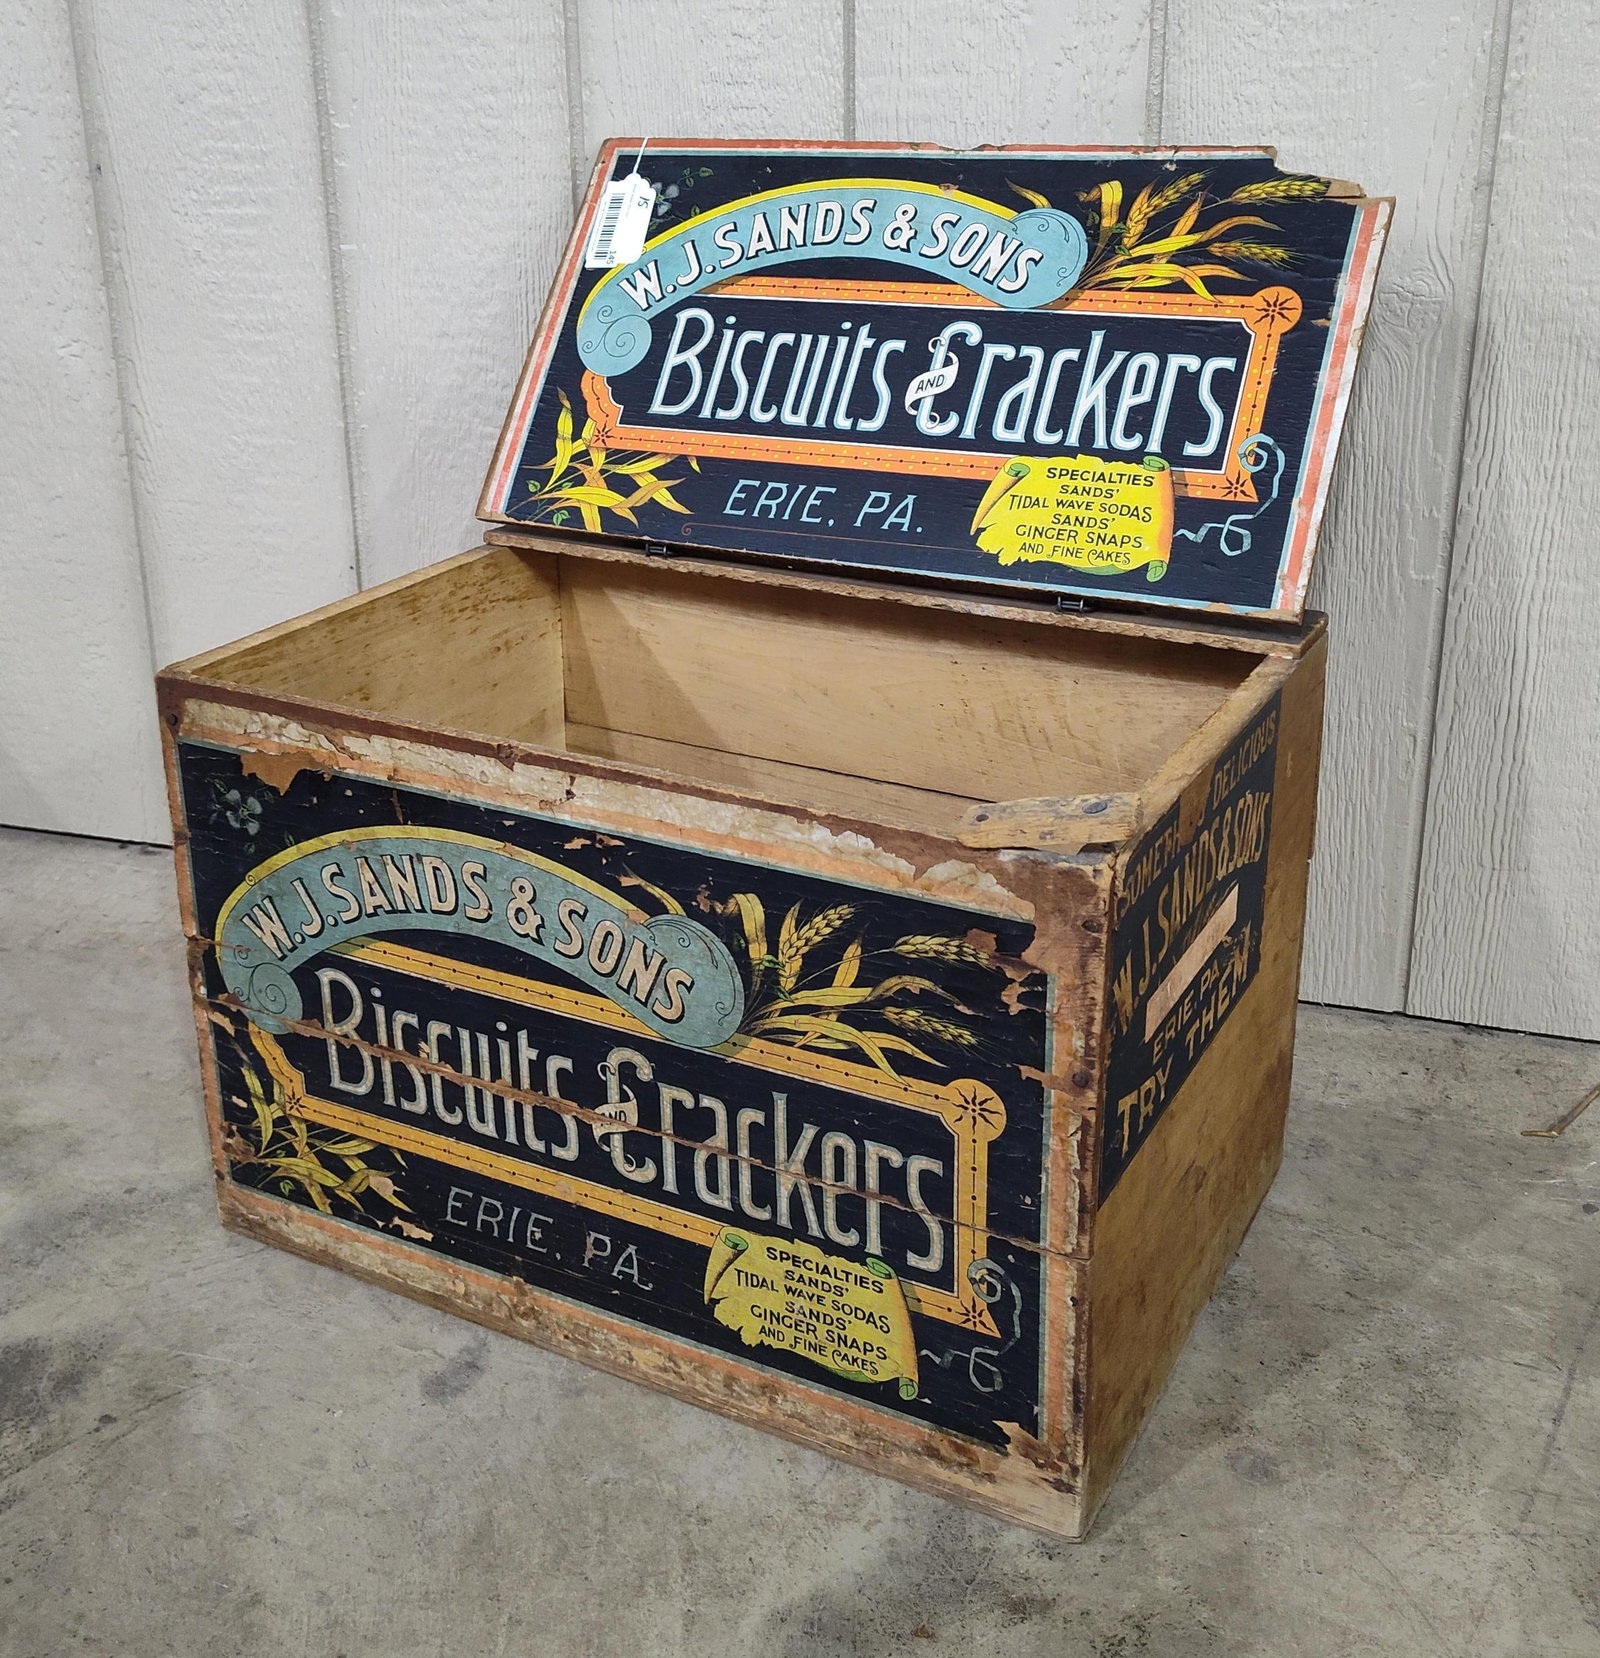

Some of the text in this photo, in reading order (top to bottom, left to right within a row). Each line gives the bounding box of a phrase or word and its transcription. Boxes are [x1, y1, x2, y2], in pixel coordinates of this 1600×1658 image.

[882, 203, 919, 251] &
[919, 207, 1043, 294] SONS
[647, 307, 1238, 458] Biscuits AND Crackers
[1046, 467, 1155, 487] SPECIALTIES
[853, 490, 923, 533] PA.
[1009, 494, 1152, 523] TIDAL WAVE SODAS
[1015, 524, 1143, 549] GINGER SNAPS
[1018, 542, 1131, 566] AND FINE CAKES
[1212, 710, 1277, 810] DELICIOUS
[1216, 806, 1232, 881] &
[1229, 791, 1271, 873] SONS
[507, 876, 544, 945] &
[554, 898, 694, 1023] SONS
[1117, 1054, 1174, 1158] TRY
[1185, 919, 1253, 1061] THEM
[315, 967, 579, 1161] Biscuits
[606, 1046, 944, 1271] Crackers
[734, 1267, 891, 1335] TIDAL WAVE SODAS
[766, 1246, 884, 1294] SPECIALTIES
[750, 1304, 888, 1361] GINGER SNAPS
[758, 1325, 879, 1376] AND FINE CAKES
